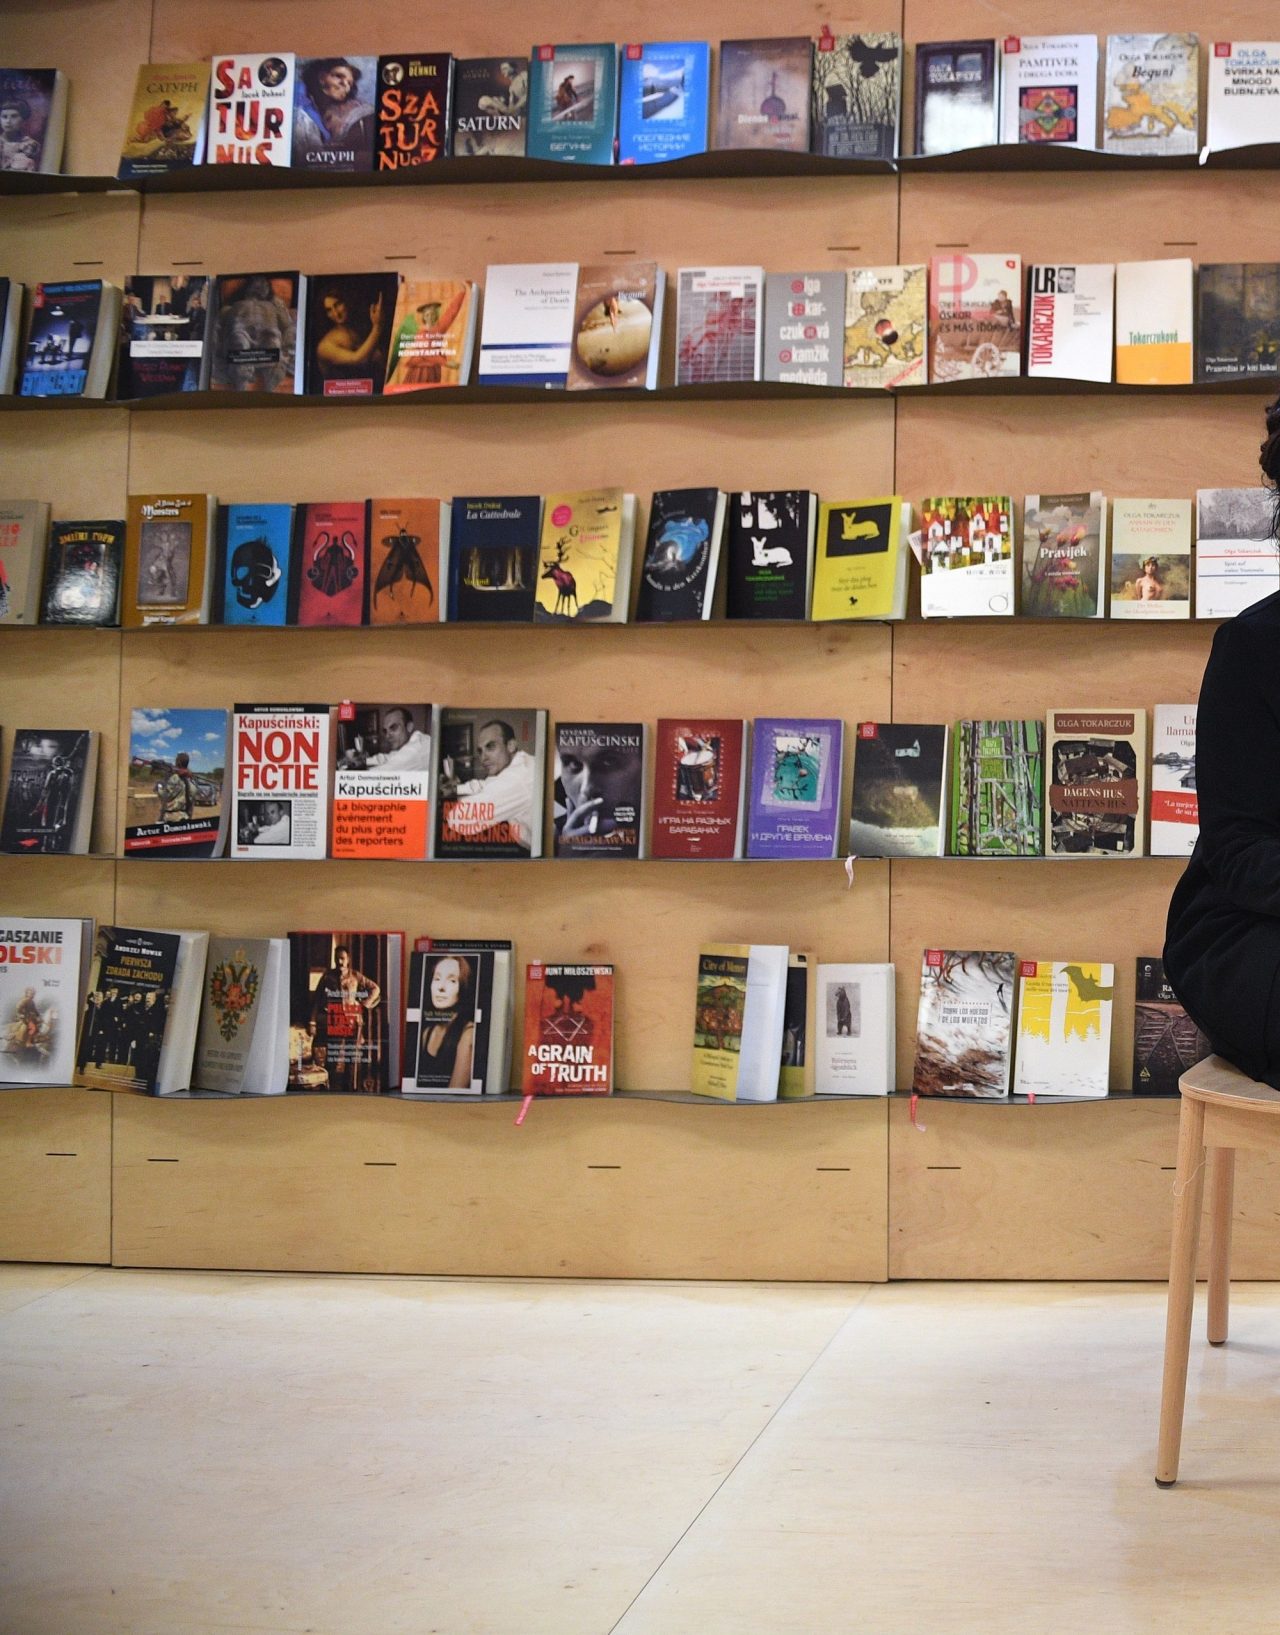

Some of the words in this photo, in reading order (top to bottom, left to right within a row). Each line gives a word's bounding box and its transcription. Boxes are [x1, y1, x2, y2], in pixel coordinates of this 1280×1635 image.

[1237, 48, 1267, 57] OLGA
[1019, 58, 1079, 68] PAMTIVEK
[1224, 67, 1262, 76] SVIRKA
[1265, 67, 1280, 75] NA
[1231, 78, 1272, 86] MNOGO
[1224, 87, 1280, 96] BUBNJEVA
[381, 89, 439, 121] SZA
[215, 101, 284, 142] TUR
[458, 116, 521, 132] SATURN
[380, 120, 440, 150] TUR
[306, 153, 355, 165] САТУРН
[1034, 267, 1055, 294] LR
[1031, 294, 1056, 367] TOKARCZUK
[1039, 546, 1088, 563] Pravijek
[239, 715, 320, 734] Kapuściński:
[1057, 719, 1080, 729] OLGA
[1081, 719, 1132, 730] TOKARCZUK
[238, 732, 319, 764] NON
[237, 764, 319, 791] FICTIE
[338, 782, 422, 799] Kapuściński
[1063, 787, 1102, 799] DAGENS
[1102, 788, 1126, 801] HUS,
[336, 802, 349, 812] La
[351, 801, 407, 815] biographie
[442, 801, 496, 820] RYSZARD
[136, 825, 161, 838] Artur
[336, 825, 349, 836] du
[351, 825, 373, 838] plus
[375, 825, 406, 838] grand
[777, 825, 809, 835] ПРАВЕК
[336, 836, 354, 847] des
[355, 836, 404, 849] reporters
[792, 833, 834, 843] ВРЕМЕНА
[527, 1045, 538, 1058] A
[537, 1044, 594, 1064] GRAIN
[530, 1061, 547, 1076] OF
[546, 1063, 607, 1083] TRUTH
